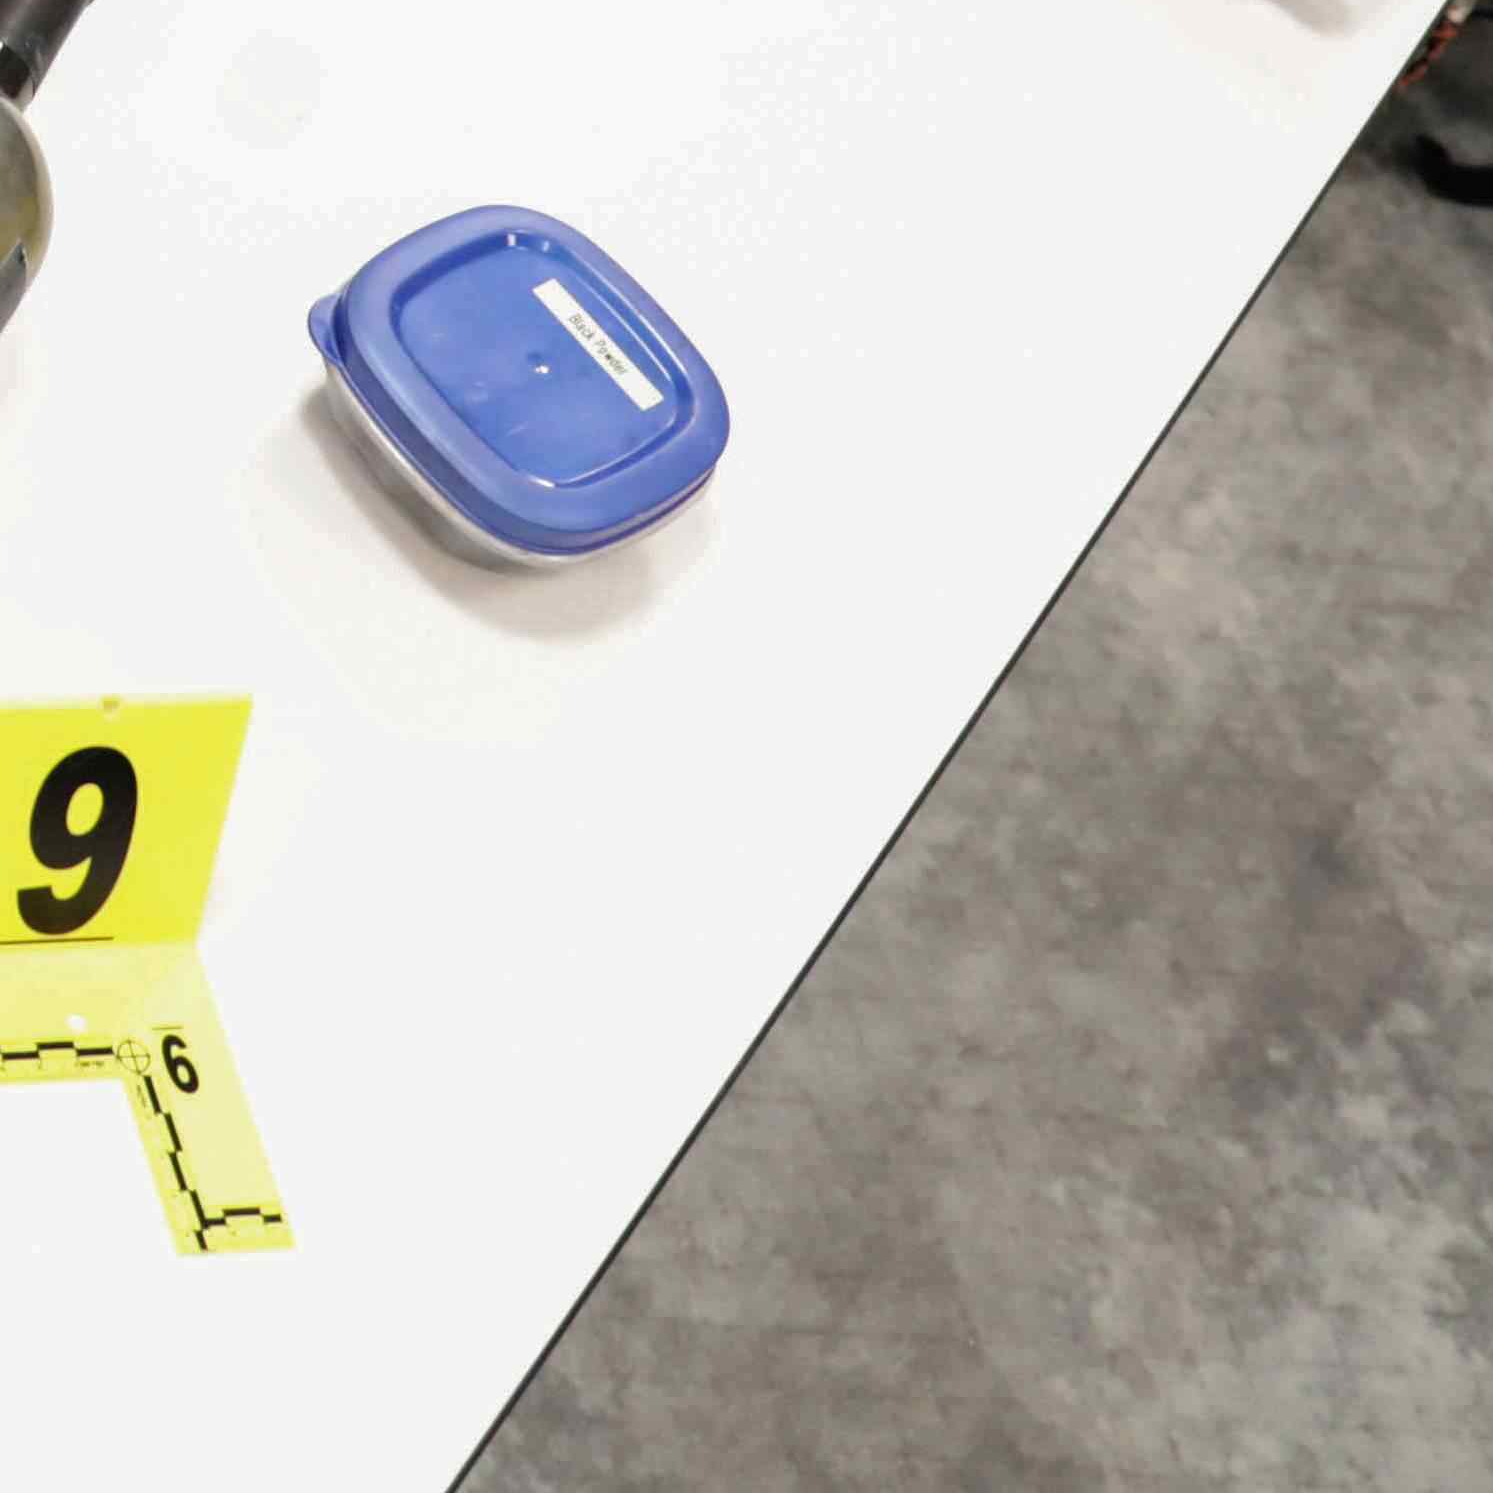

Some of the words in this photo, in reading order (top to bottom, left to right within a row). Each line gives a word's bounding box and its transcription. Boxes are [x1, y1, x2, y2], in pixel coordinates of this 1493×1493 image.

[568, 312, 595, 341] Black
[593, 339, 629, 375] Powder
[16, 744, 139, 937] 9
